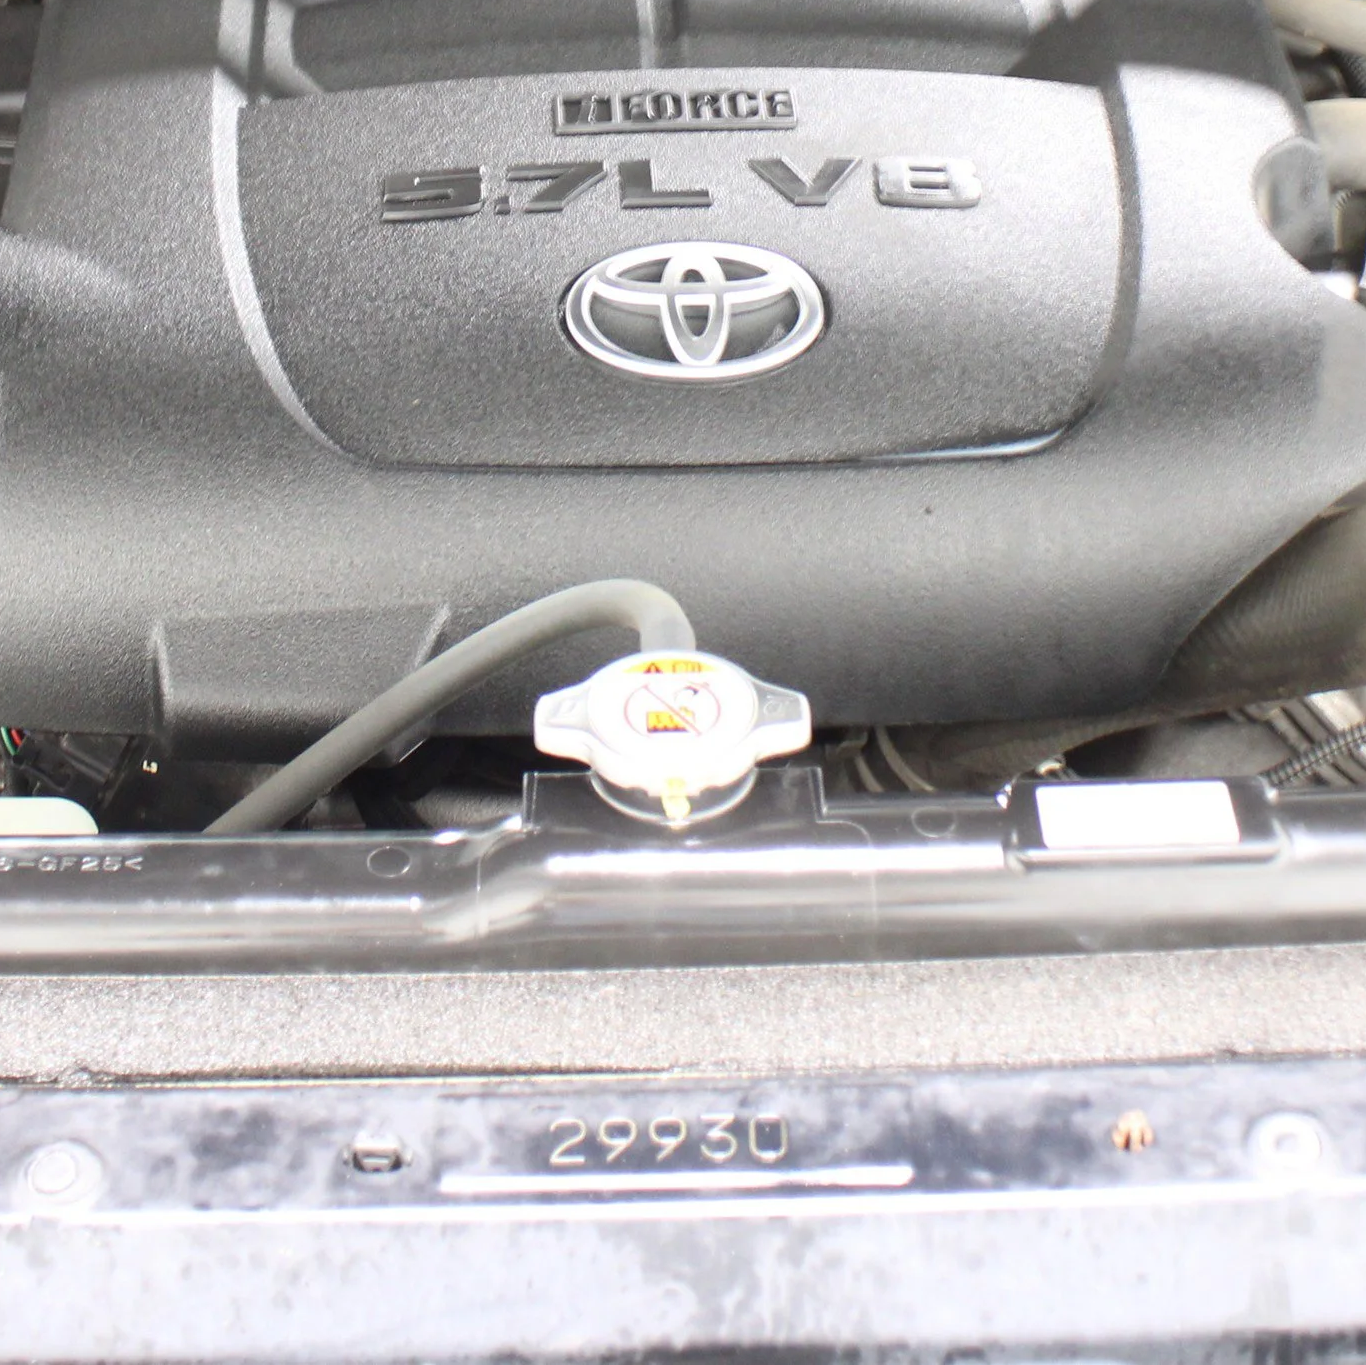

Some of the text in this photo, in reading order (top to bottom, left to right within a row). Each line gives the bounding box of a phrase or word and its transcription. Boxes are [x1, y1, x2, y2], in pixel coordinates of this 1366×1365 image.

[381, 154, 982, 222] 5.7L V8
[548, 1113, 790, 1166] 29930
